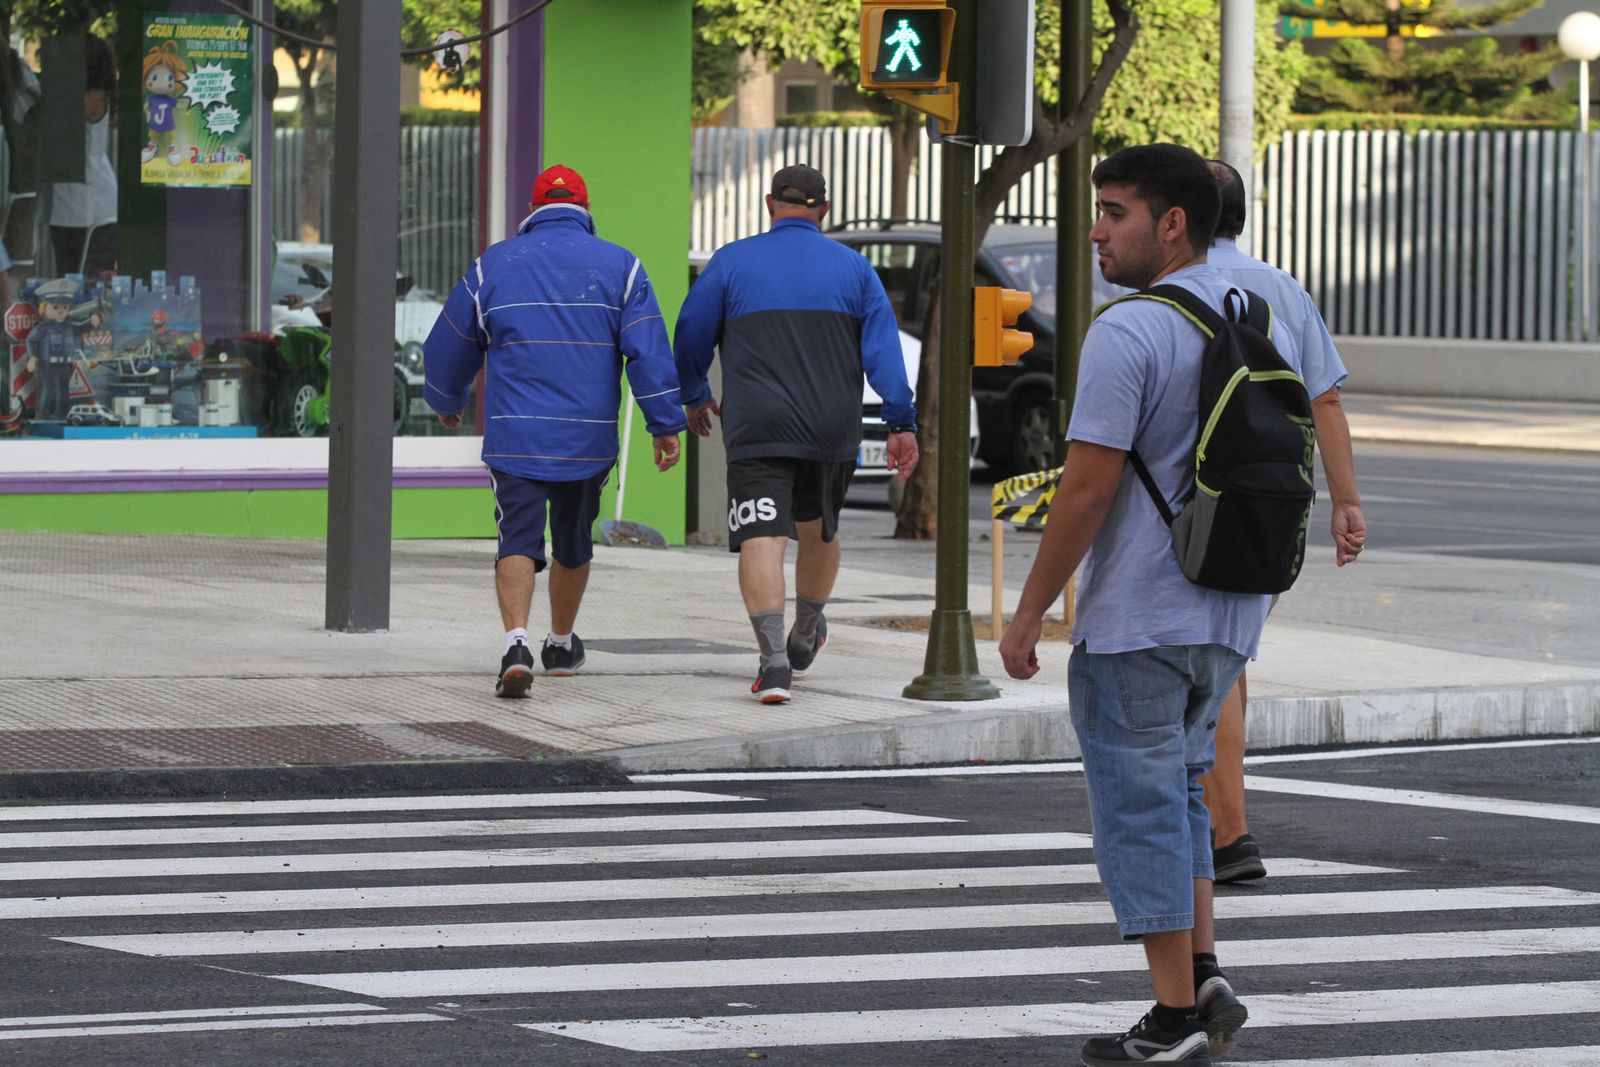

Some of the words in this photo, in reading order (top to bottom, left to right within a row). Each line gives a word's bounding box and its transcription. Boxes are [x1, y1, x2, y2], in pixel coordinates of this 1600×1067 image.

[146, 23, 174, 38] GRAN
[174, 19, 249, 40] INAUGURACIÓN
[154, 103, 168, 125] J
[8, 313, 39, 330] STOP
